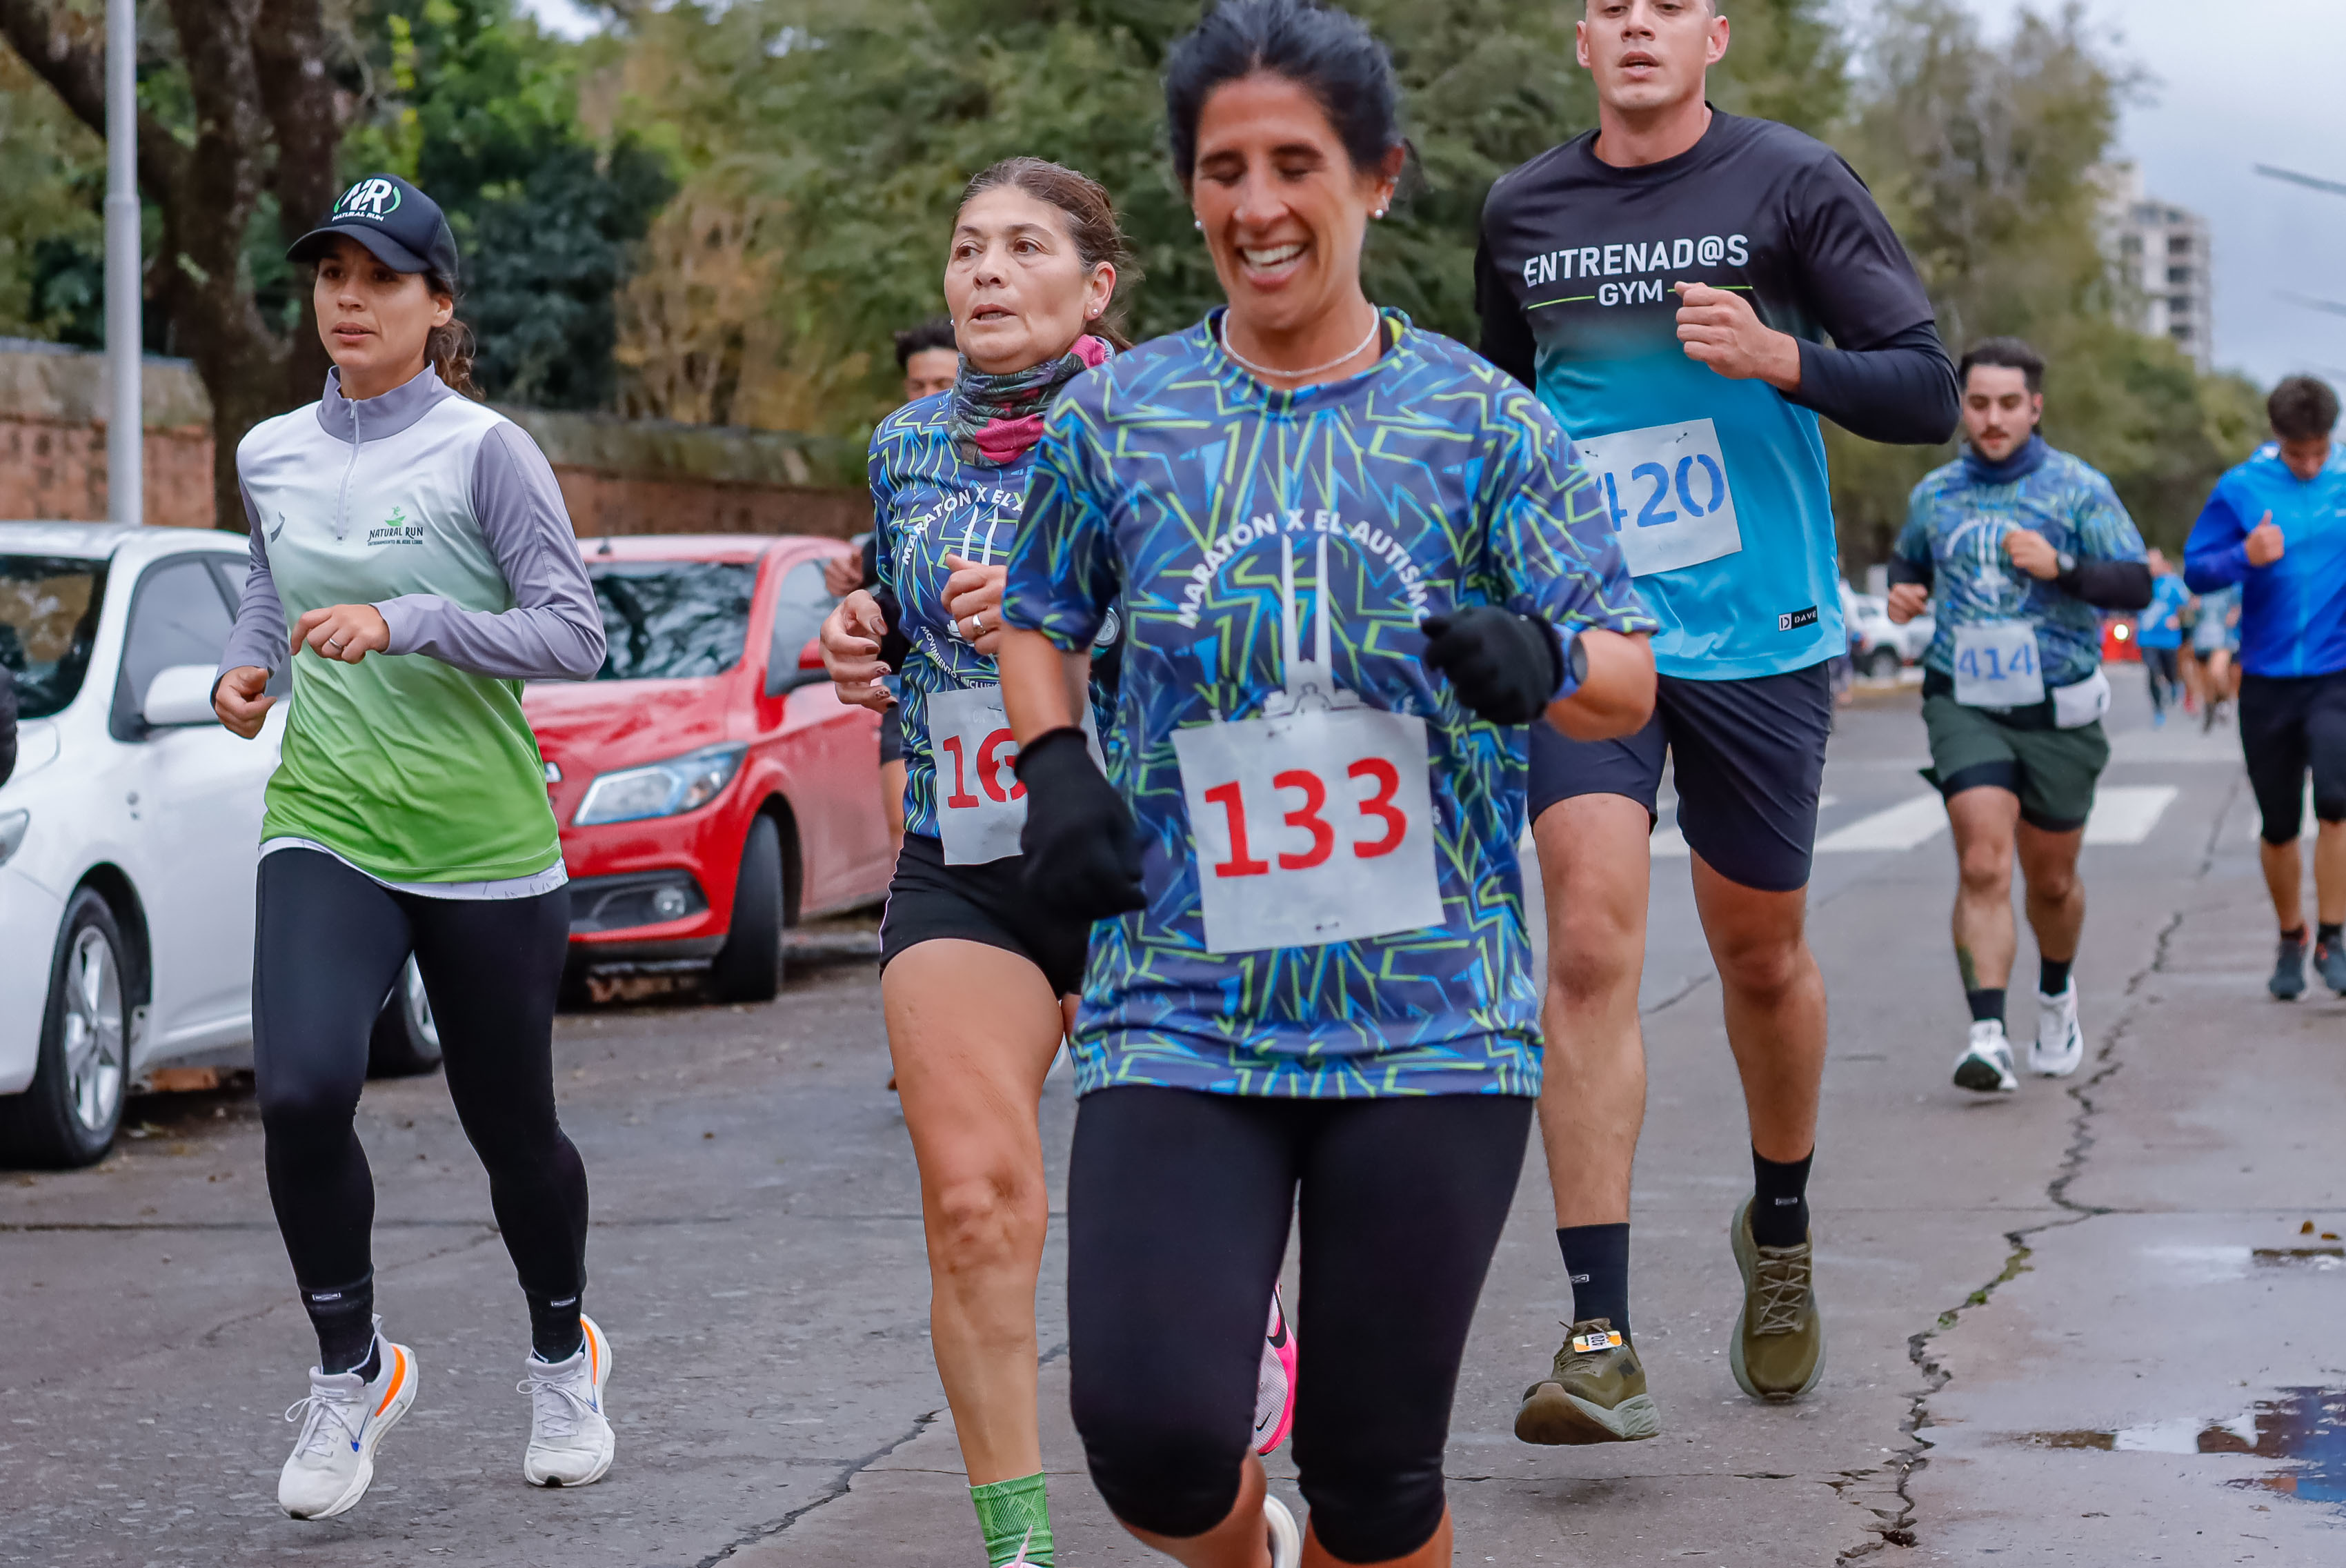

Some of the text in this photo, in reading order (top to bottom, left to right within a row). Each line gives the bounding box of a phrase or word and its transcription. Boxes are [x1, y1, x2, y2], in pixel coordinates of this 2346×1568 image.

[332, 211, 384, 221] NATURAL RUN
[1523, 234, 1749, 288] ENTRENAD@S
[1598, 279, 1663, 306] GYM
[976, 486, 988, 503] X
[991, 488, 1011, 507] EL
[367, 527, 423, 542] NATURAL RUN
[1285, 508, 1306, 532] X
[1313, 508, 1344, 535] EL
[1795, 611, 1816, 623] DAVE
[920, 626, 959, 681] MOVIMIENTO.
[1957, 644, 2034, 681] 414
[1204, 757, 1408, 877] 133
[1591, 1335, 1605, 1346] 420
